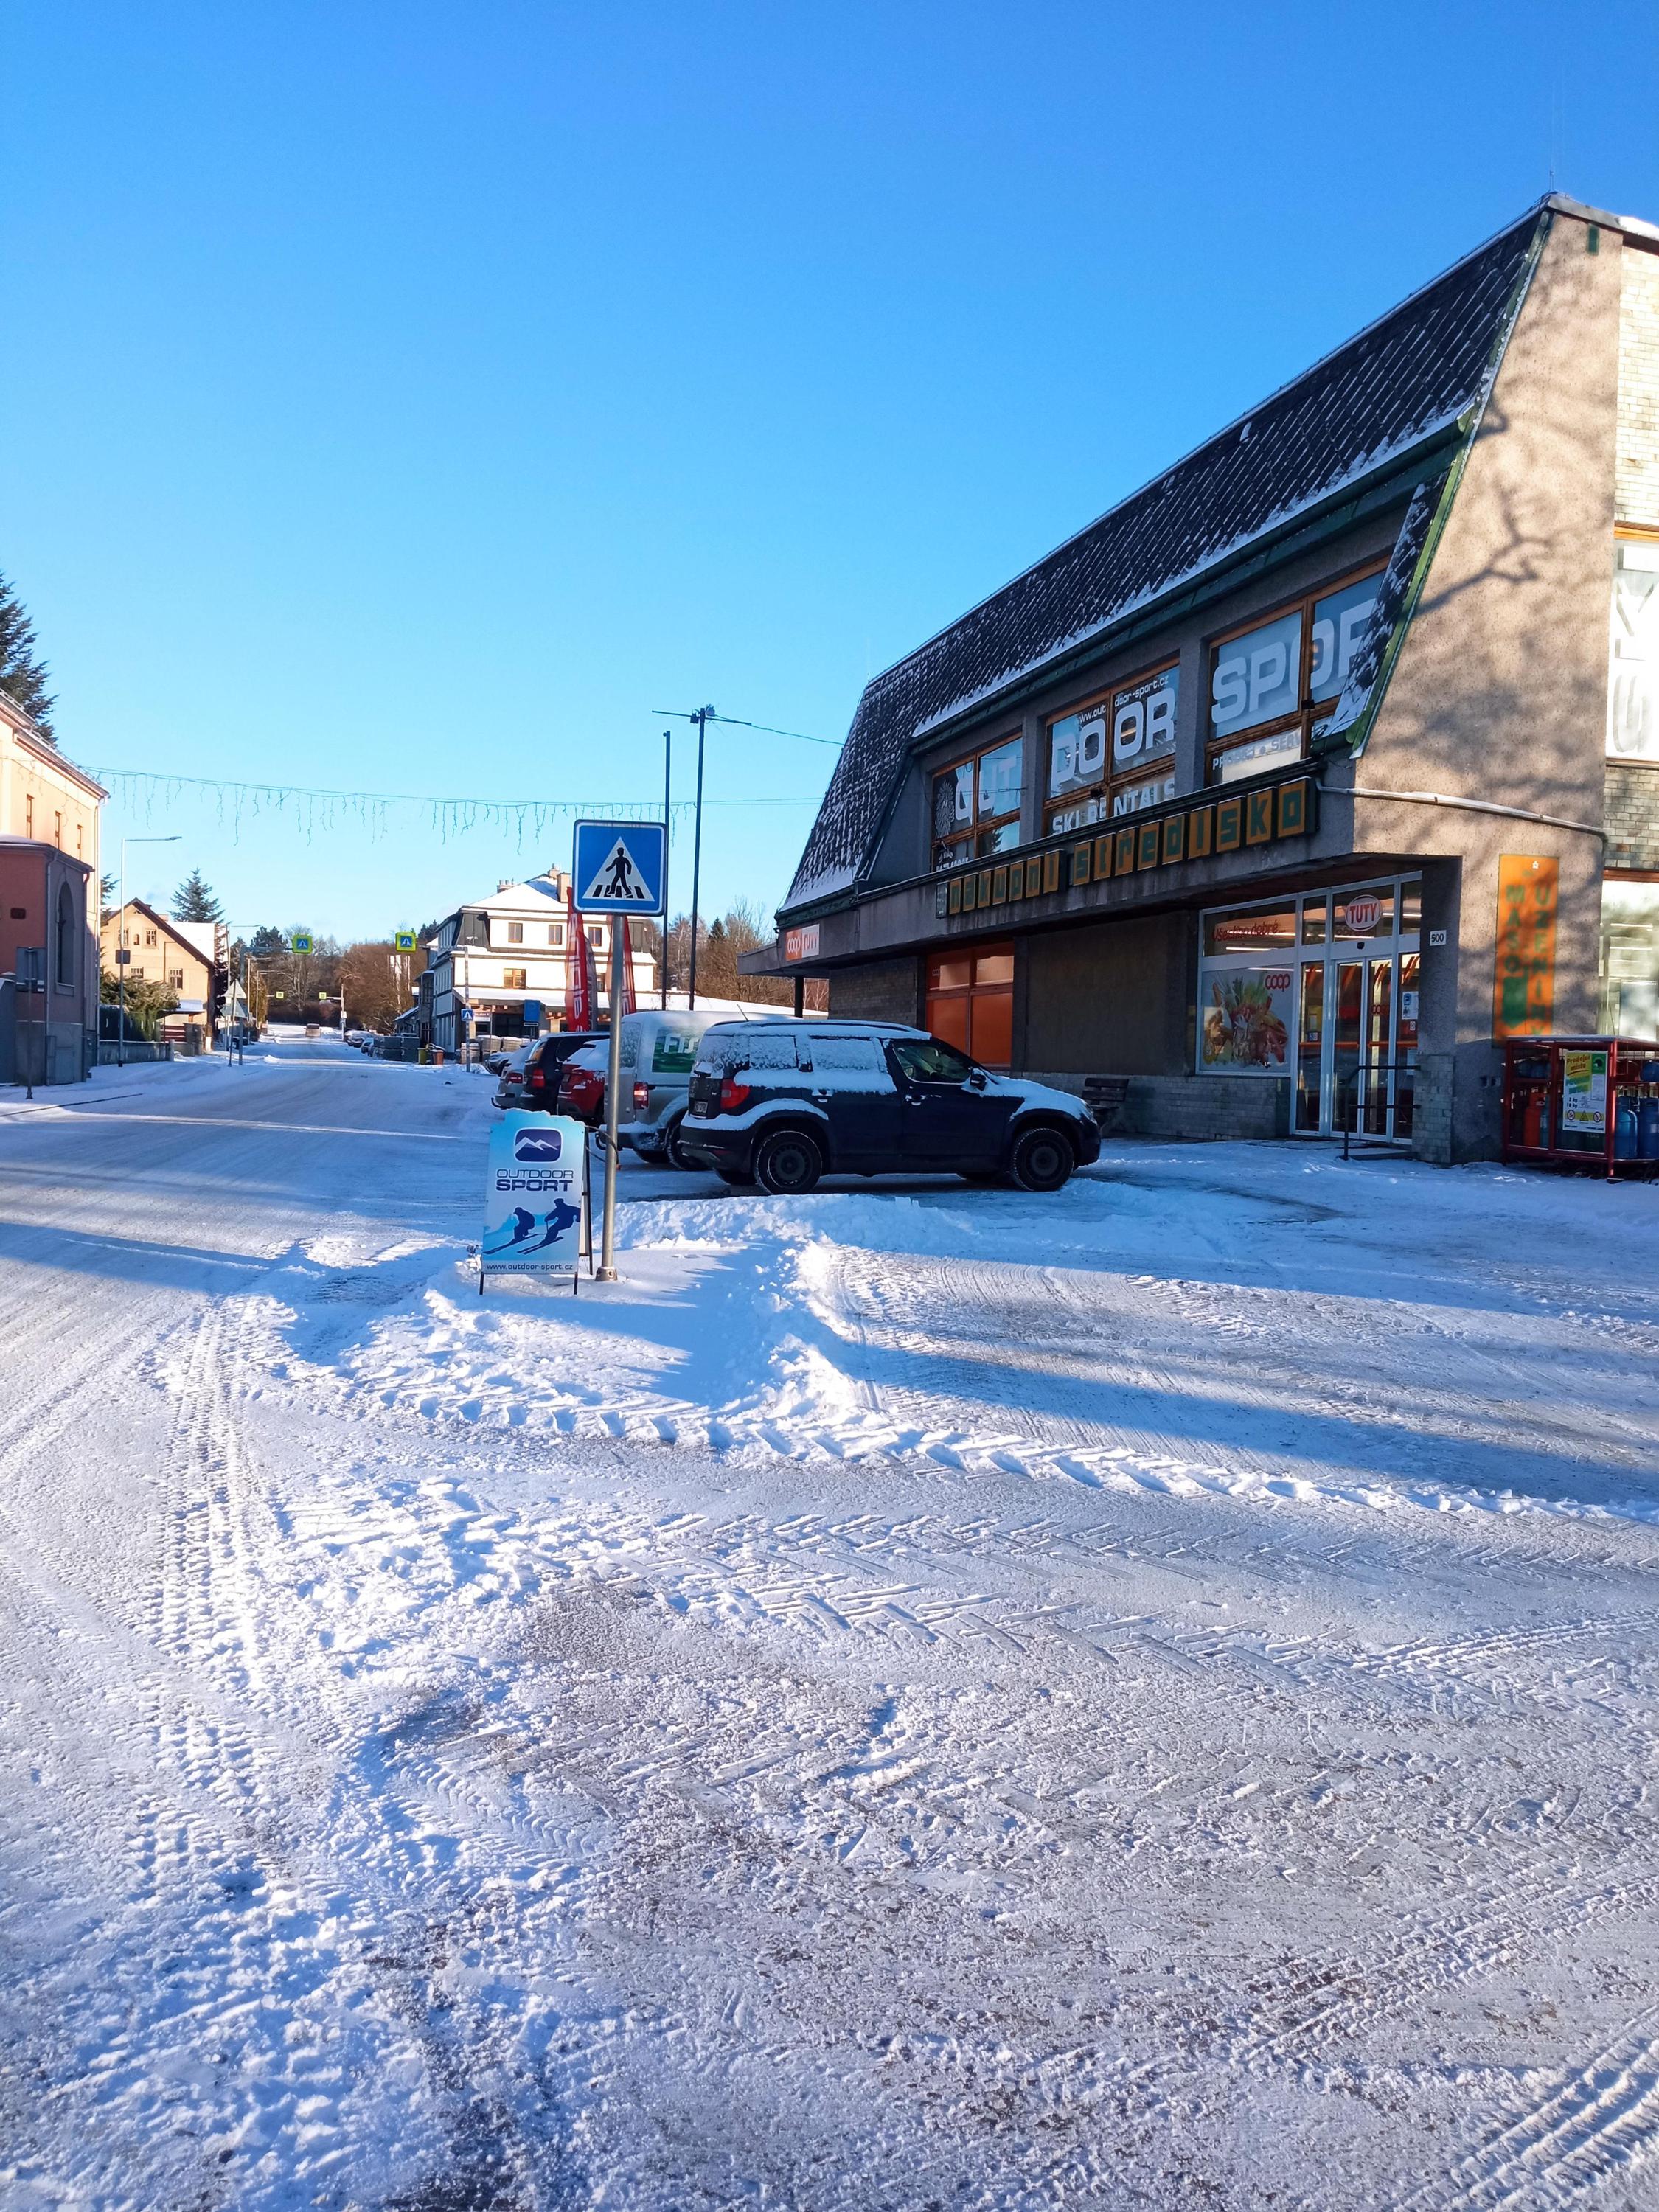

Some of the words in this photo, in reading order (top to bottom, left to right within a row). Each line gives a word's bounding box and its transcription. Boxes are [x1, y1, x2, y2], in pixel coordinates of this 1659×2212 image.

[1051, 687, 1175, 798] DOOR
[1052, 810, 1079, 835] SKI
[1349, 902, 1378, 924] TUTY
[1430, 933, 1444, 943] 500
[1265, 973, 1290, 992] coop
[496, 1169, 574, 1179] OUTDOOR
[495, 1179, 574, 1192] SPORT
[487, 1262, 573, 1271] www.outdoor-sport.cz
